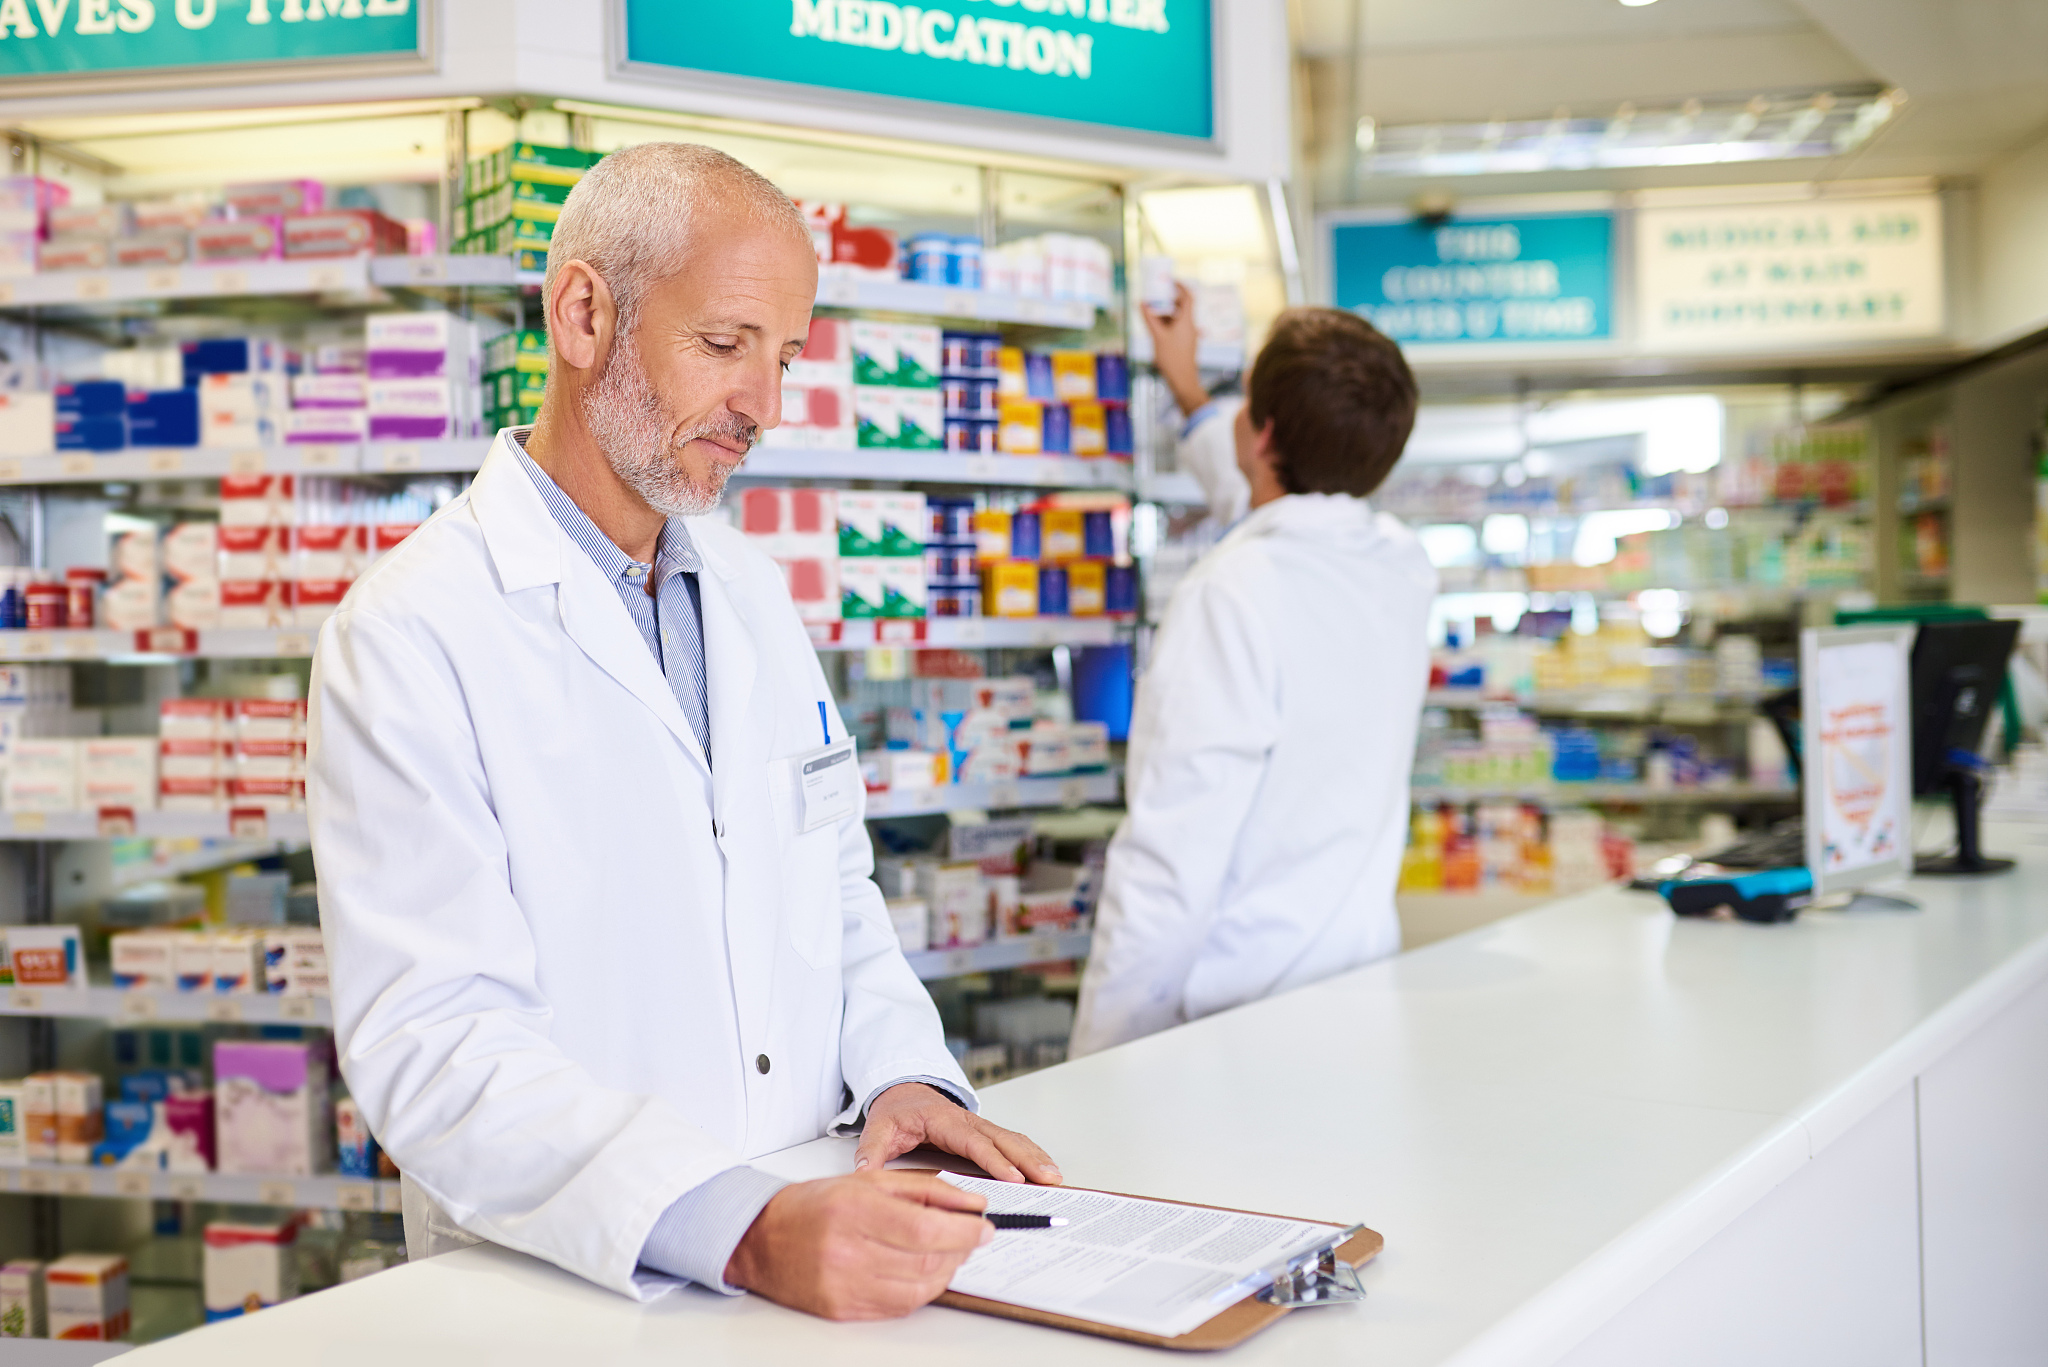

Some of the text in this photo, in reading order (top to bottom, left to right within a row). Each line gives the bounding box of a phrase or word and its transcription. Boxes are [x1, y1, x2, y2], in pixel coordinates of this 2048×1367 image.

[789, 0, 1094, 79] MEDICATION
[1436, 224, 1521, 261] THIS
[1382, 260, 1560, 301] COUNTER
[1502, 297, 1597, 336] TIME
